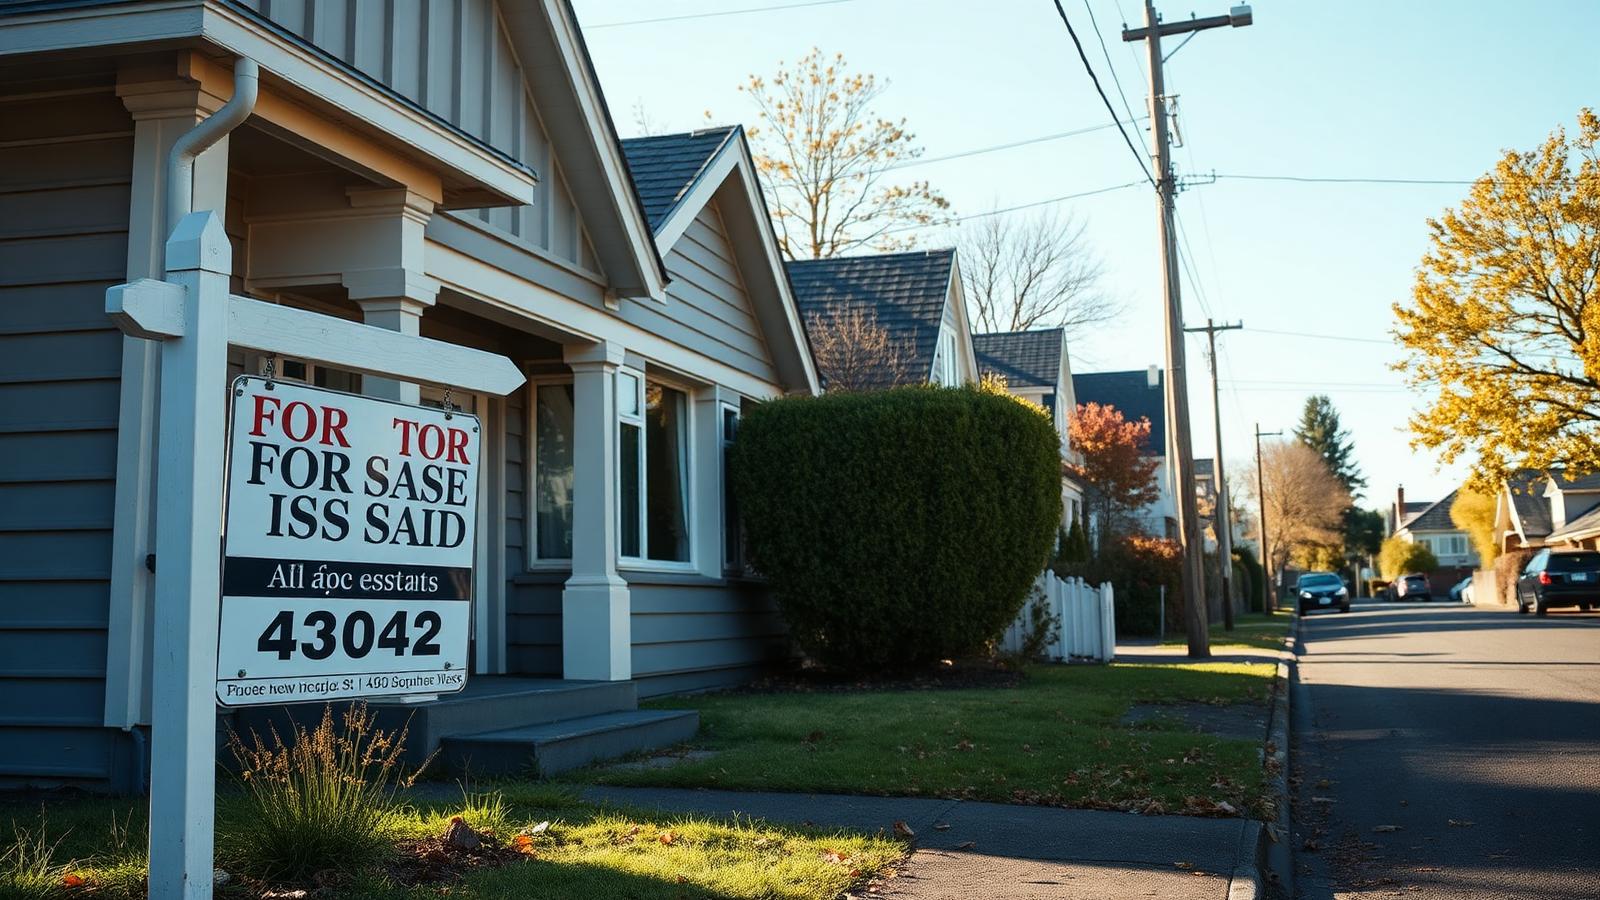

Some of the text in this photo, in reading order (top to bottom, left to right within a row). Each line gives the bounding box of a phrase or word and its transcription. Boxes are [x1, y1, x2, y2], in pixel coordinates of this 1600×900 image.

[248, 394, 471, 466] FOR TOR
[246, 441, 468, 508] FOR SASE
[265, 493, 466, 549] ISS SAID
[256, 610, 442, 661] 43042
